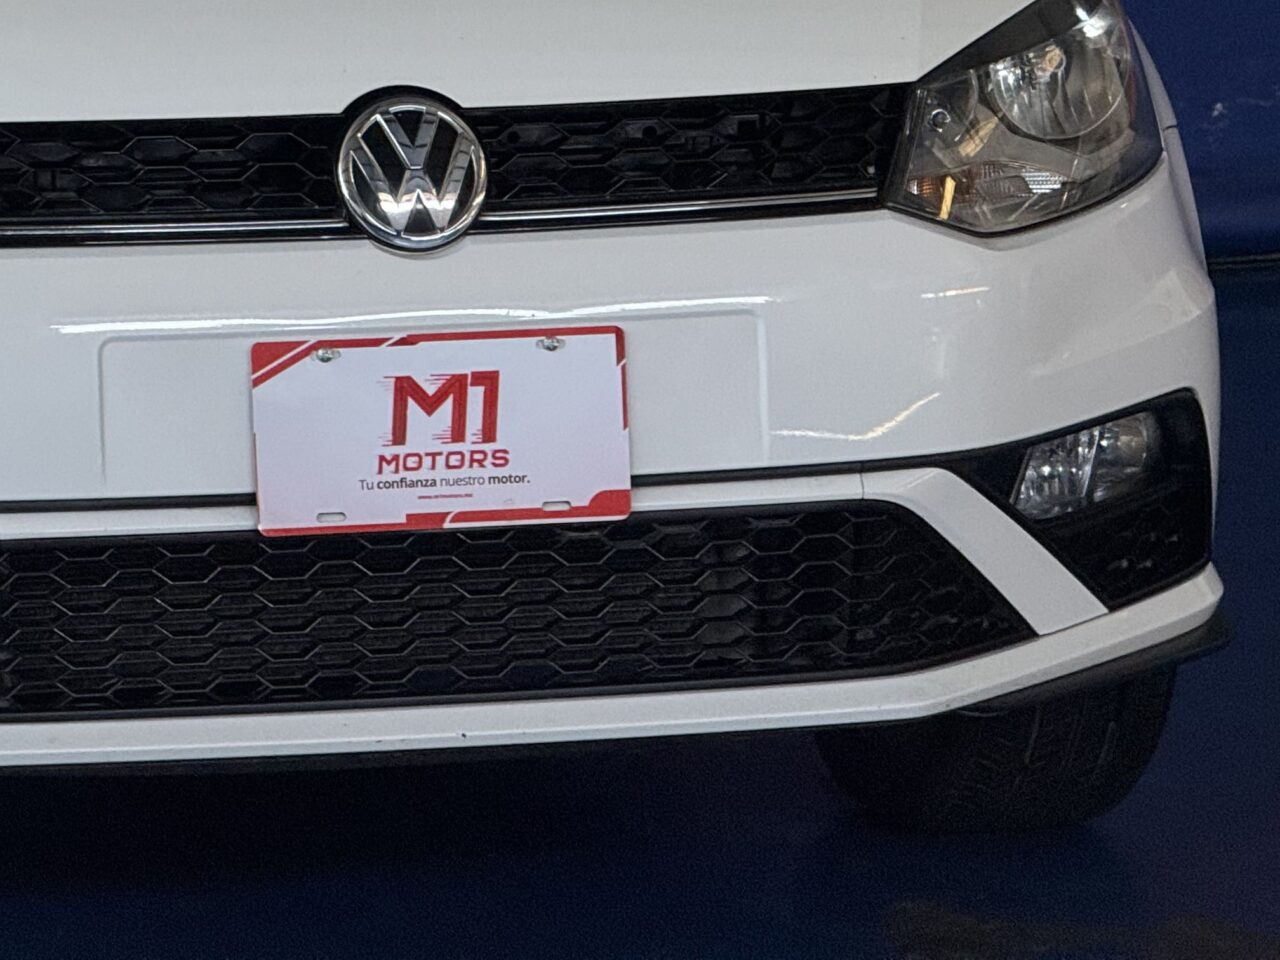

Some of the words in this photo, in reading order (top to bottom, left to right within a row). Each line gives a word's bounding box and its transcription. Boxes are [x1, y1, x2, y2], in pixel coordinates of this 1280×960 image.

[380, 370, 501, 447] M1
[376, 448, 510, 475] MOTORS
[358, 479, 375, 491] Tu
[376, 477, 438, 490] confianza
[439, 475, 486, 487] nuestro
[487, 473, 532, 486] motor.
